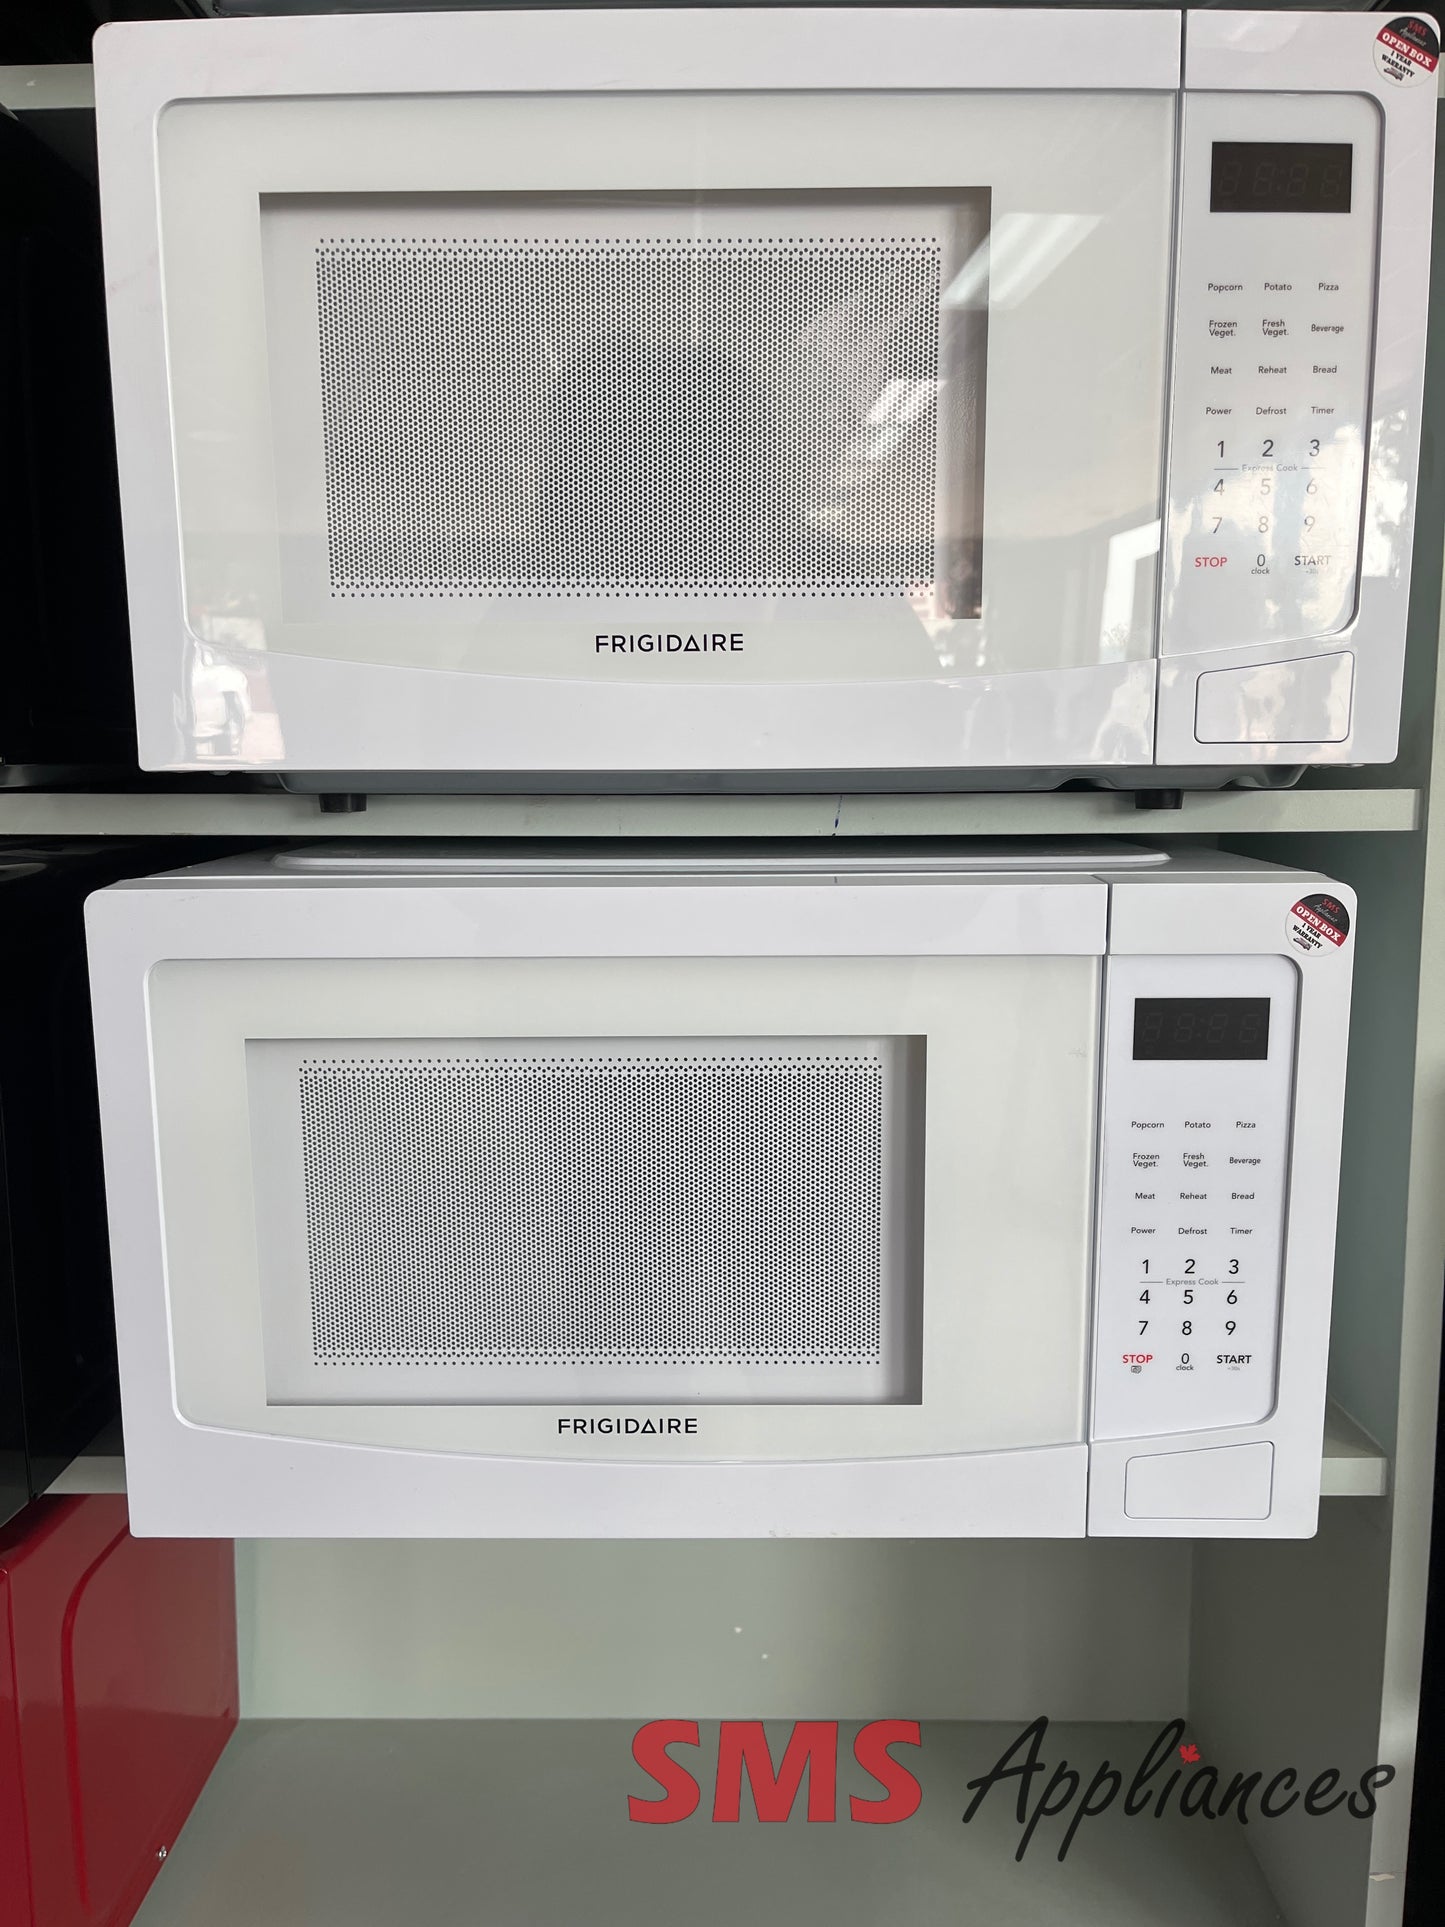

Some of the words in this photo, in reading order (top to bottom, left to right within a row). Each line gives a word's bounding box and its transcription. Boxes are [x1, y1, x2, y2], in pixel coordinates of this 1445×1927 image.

[1382, 32, 1411, 54] OPEN
[1409, 48, 1433, 67] BOX
[1395, 52, 1412, 67] YEAR
[1381, 54, 1415, 78] WARRANTY
[1208, 283, 1243, 292] Popcorn
[1264, 283, 1292, 291] Potato
[1319, 283, 1339, 291] Pizza
[1209, 320, 1237, 328] Frozen
[1263, 319, 1285, 327] Fresh
[1311, 324, 1344, 333] Beverage
[1209, 329, 1236, 338] Veget.
[1263, 329, 1289, 337] Veget.
[1258, 366, 1287, 374] Reheat
[1312, 365, 1337, 374] Bread
[1206, 407, 1232, 415] Power
[1256, 406, 1286, 415] Defrost
[1311, 406, 1334, 414] Timer
[1217, 441, 1225, 457] 1
[1262, 440, 1274, 457] 2
[1309, 439, 1320, 457] 3
[1242, 463, 1274, 472] Express
[1277, 463, 1298, 472] Cook
[1213, 478, 1225, 496] 4
[1260, 478, 1271, 495] 5
[1306, 478, 1318, 495] 6
[1212, 517, 1223, 533] 7
[1258, 517, 1269, 533] 8
[1304, 516, 1315, 533] 9
[1195, 557, 1227, 568] STOP
[1256, 554, 1266, 567] 0
[1294, 556, 1331, 566] START
[1251, 567, 1269, 575] clock
[595, 633, 744, 653] FRIGIDAIRE
[1296, 906, 1322, 927] OPEN
[1319, 923, 1341, 942] BOX
[1292, 924, 1323, 949] WARRANTY
[1306, 925, 1322, 939] YEAR
[1131, 1121, 1164, 1129] Popcorn
[1185, 1121, 1211, 1129] Potato
[1236, 1121, 1256, 1129] Pizza
[1133, 1160, 1158, 1168] Veget.
[1229, 1157, 1261, 1165] Beverage
[1180, 1192, 1207, 1200] Reheat
[1231, 1192, 1254, 1200] Bread
[1178, 1227, 1207, 1235] Defrost
[1230, 1227, 1252, 1235] Timer
[1142, 1259, 1149, 1273] 1
[1185, 1259, 1195, 1273] 2
[1229, 1259, 1239, 1274] 3
[1166, 1278, 1196, 1286] Express
[1139, 1290, 1150, 1304] 4
[1183, 1290, 1193, 1304] 5
[1227, 1290, 1237, 1304] 6
[1138, 1321, 1148, 1335] 7
[1182, 1321, 1192, 1335] 8
[1225, 1321, 1236, 1335] 9
[1122, 1355, 1153, 1363] STOP
[1181, 1353, 1189, 1364] 0
[1217, 1355, 1252, 1364] START
[558, 1418, 698, 1434] FRIGIDAIRE
